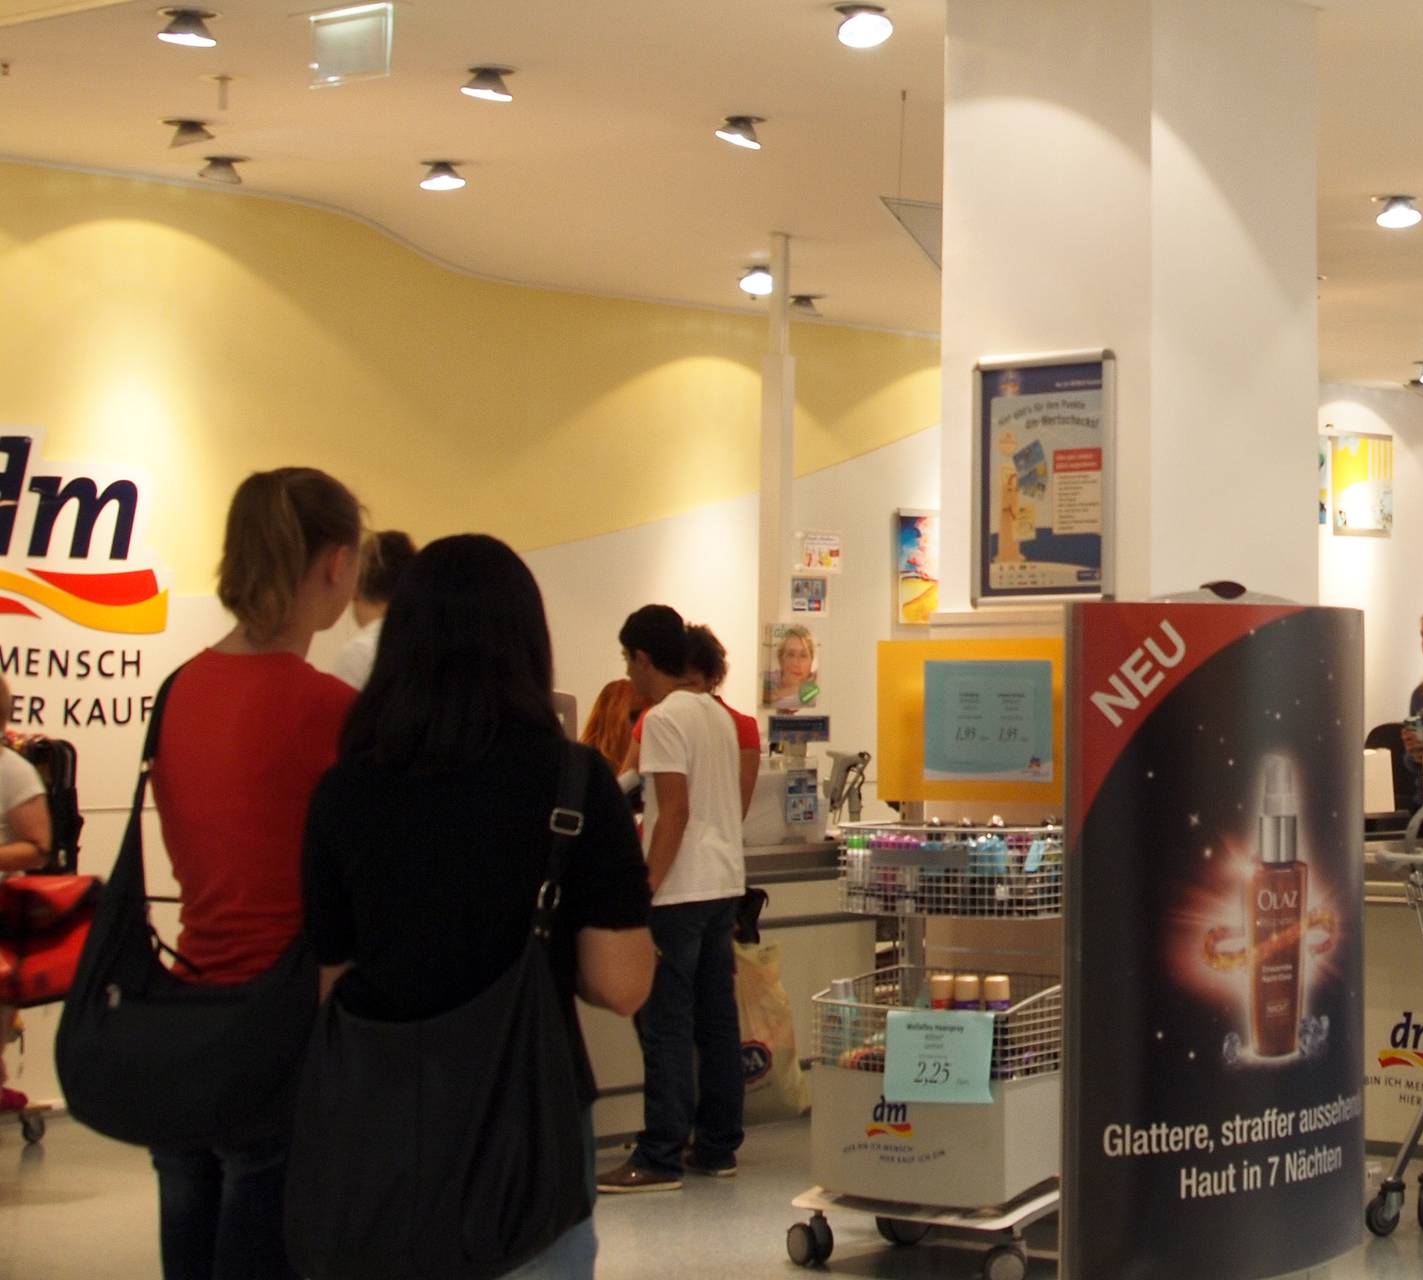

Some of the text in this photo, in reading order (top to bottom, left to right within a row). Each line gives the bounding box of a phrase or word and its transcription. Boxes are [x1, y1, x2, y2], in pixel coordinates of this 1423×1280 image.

[0, 645, 140, 678] MENSCH
[1089, 619, 1187, 728] NEU
[10, 695, 44, 726] ER
[873, 1094, 908, 1122] dm
[1103, 1123, 1214, 1157] Glattere,
[1221, 1108, 1295, 1147] straffer
[1180, 1146, 1342, 1199] Haut in 7 Nächten
